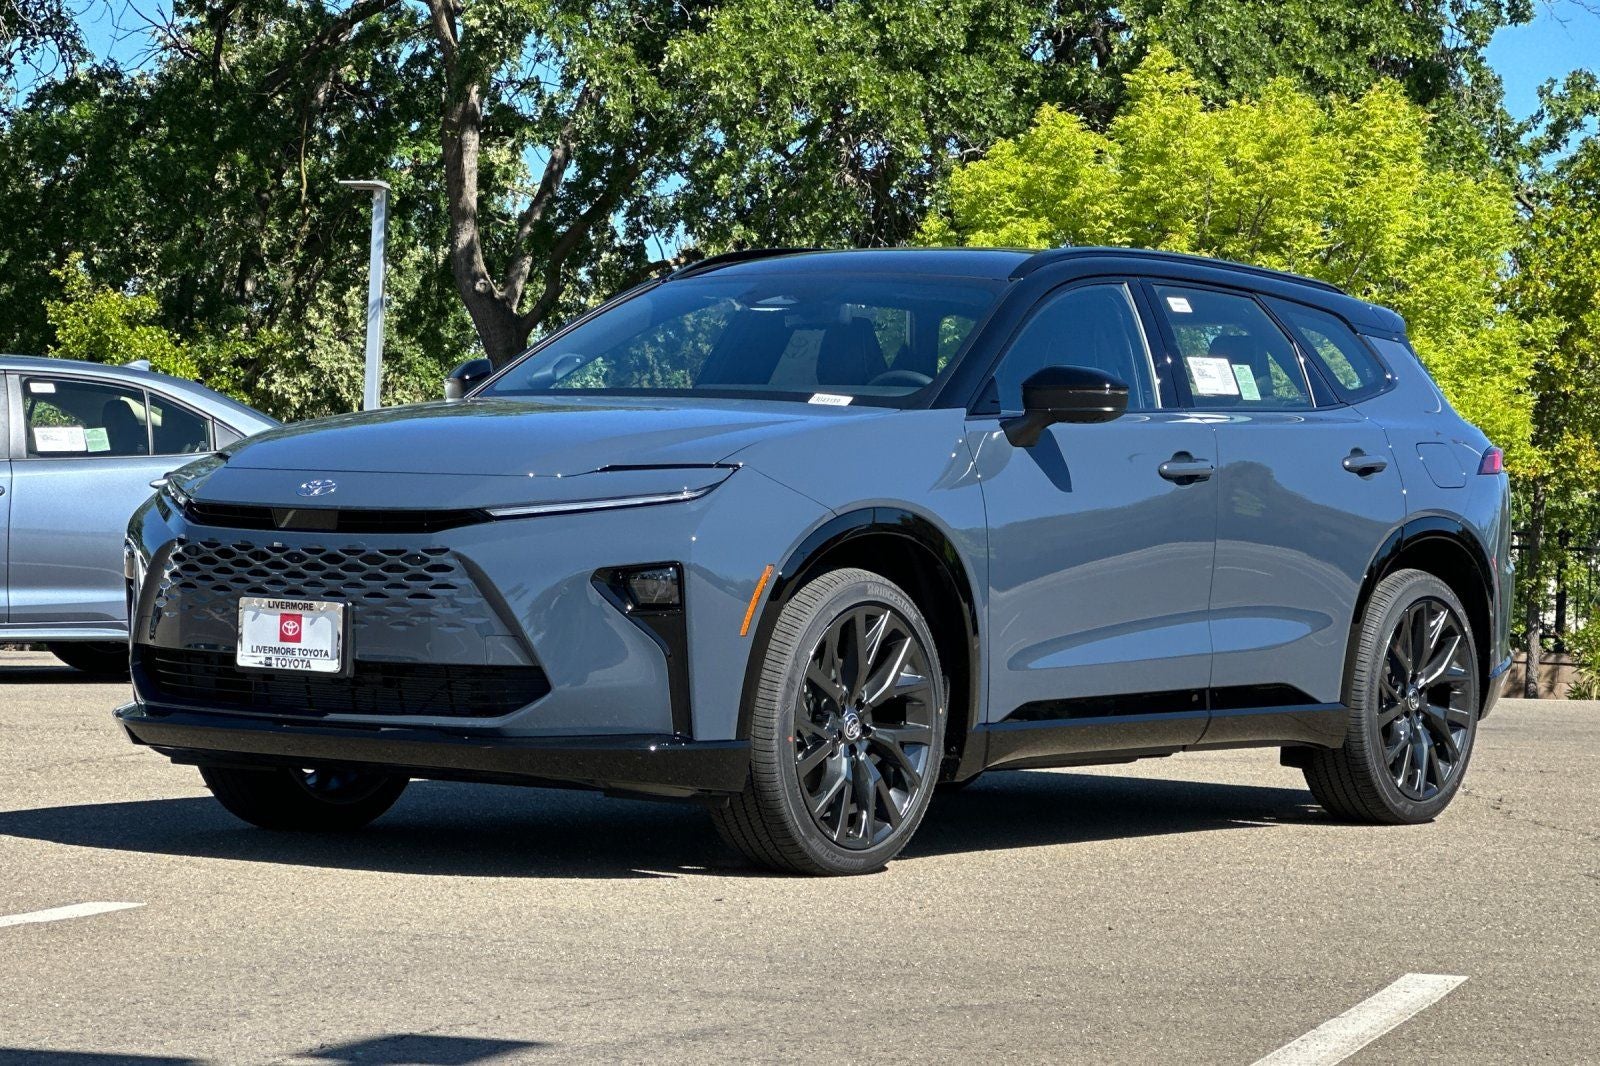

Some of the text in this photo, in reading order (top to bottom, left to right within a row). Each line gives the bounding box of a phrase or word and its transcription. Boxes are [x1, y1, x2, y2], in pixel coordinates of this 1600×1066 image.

[268, 600, 314, 611] LIVERMORE
[866, 583, 918, 624] BRIDGESTONE
[251, 645, 329, 658] LIVERMORE TOYOTA
[275, 658, 312, 669] TOYOTA
